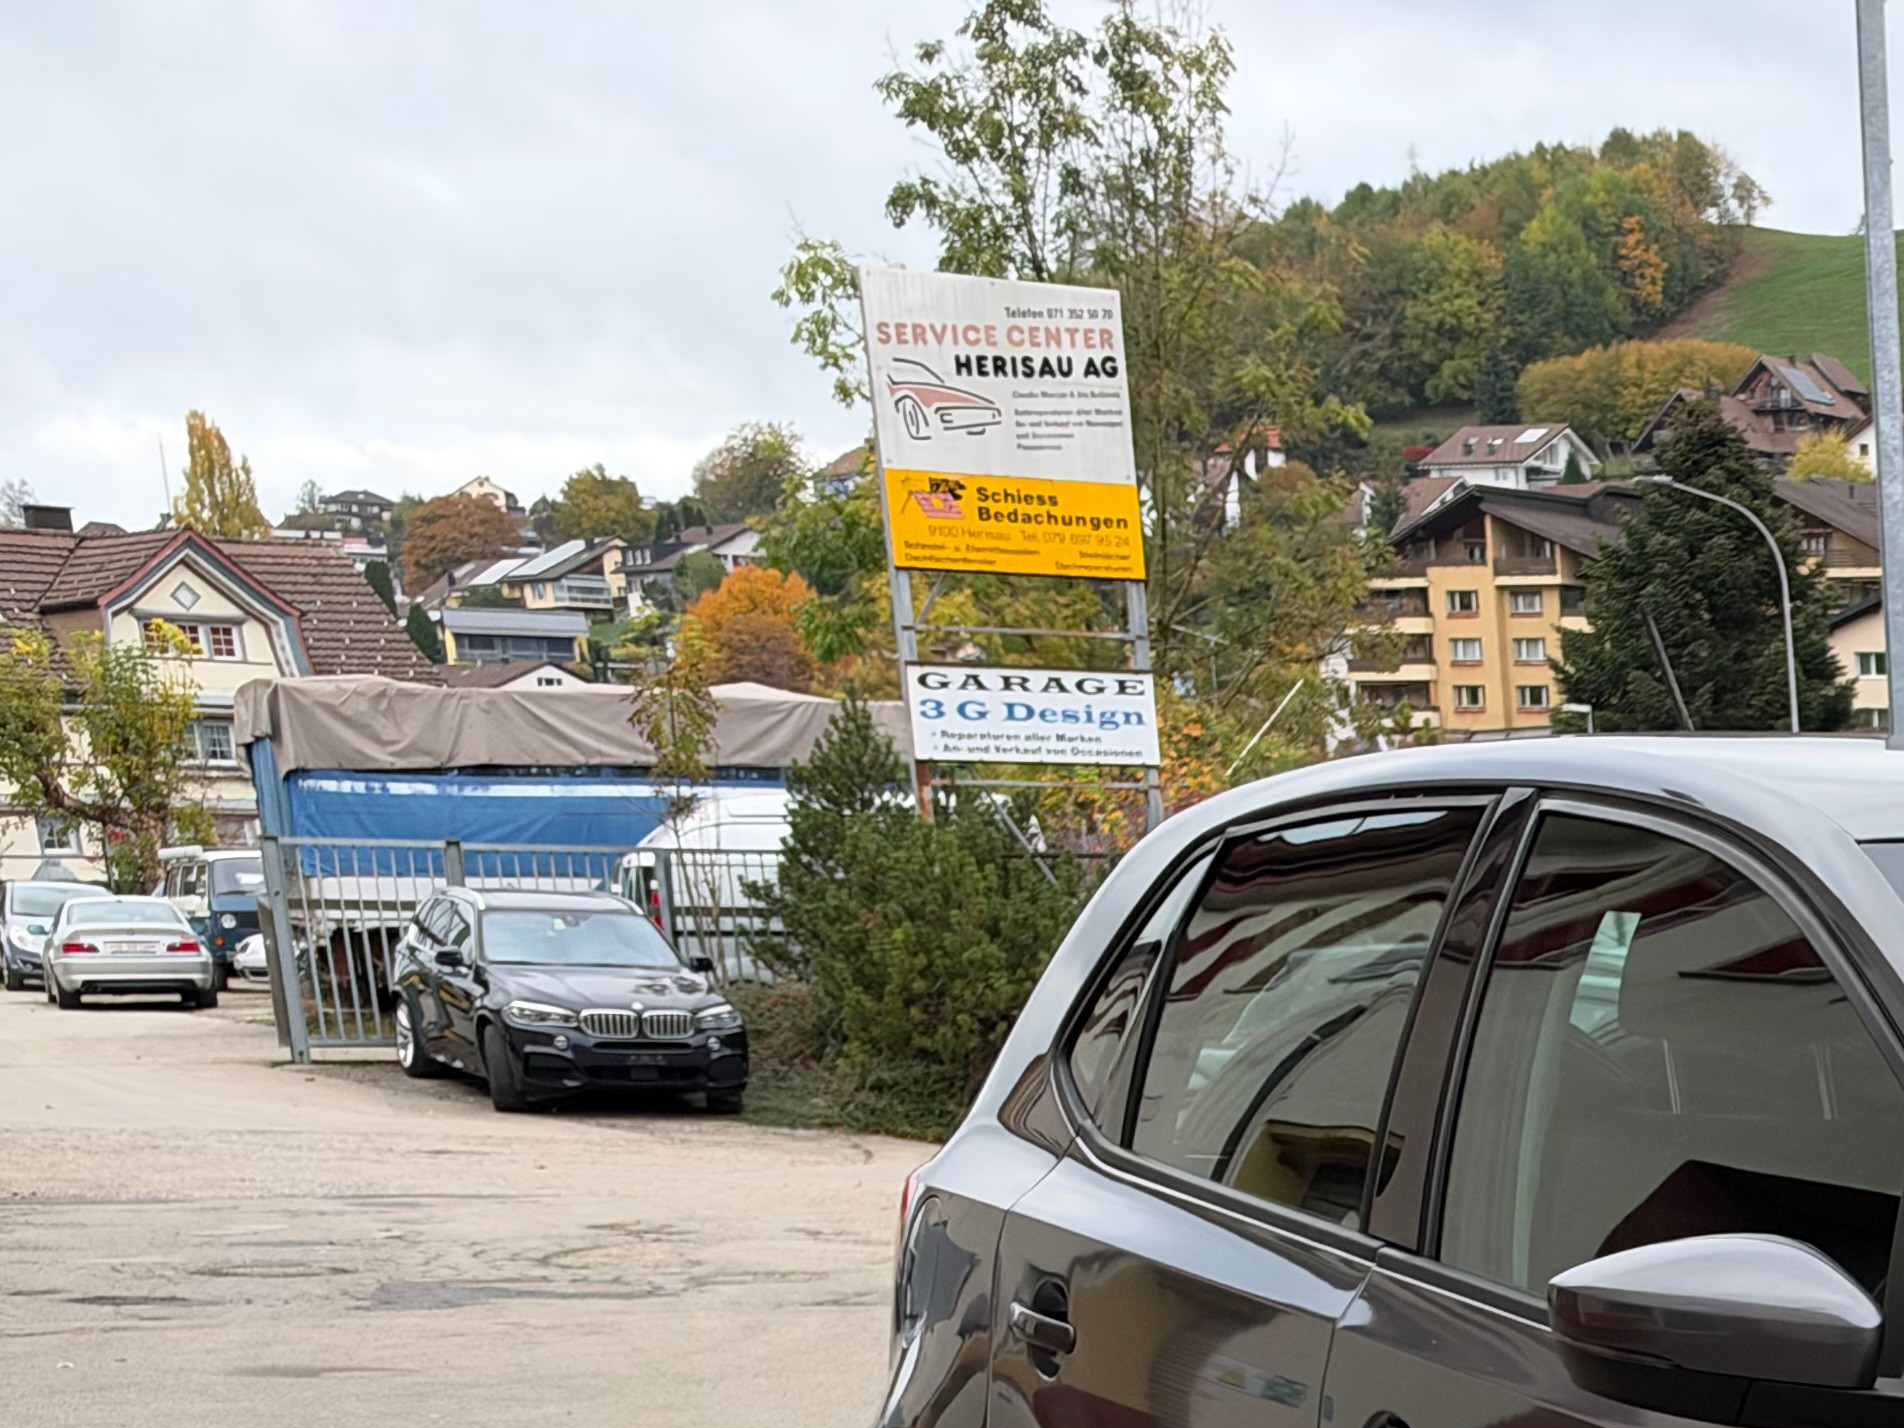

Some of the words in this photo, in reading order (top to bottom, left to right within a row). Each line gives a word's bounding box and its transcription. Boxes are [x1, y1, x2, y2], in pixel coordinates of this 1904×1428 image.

[1004, 306, 1044, 319] Telefon
[1047, 307, 1064, 319] 071
[1102, 308, 1114, 320] 70
[875, 321, 998, 348] SERVICE
[1006, 324, 1115, 351] CENTER
[954, 353, 1074, 379] HERISAU
[1083, 355, 1119, 379] AG
[976, 486, 1059, 507] Schiess
[927, 524, 959, 538] 9100
[977, 506, 1129, 531] Bedachungen
[916, 671, 1146, 696] GARAGE
[919, 698, 946, 720] 3
[956, 699, 990, 722] G
[1002, 702, 1147, 731] Design
[940, 730, 1021, 743] Reparaturen
[1055, 733, 1102, 744] Marken
